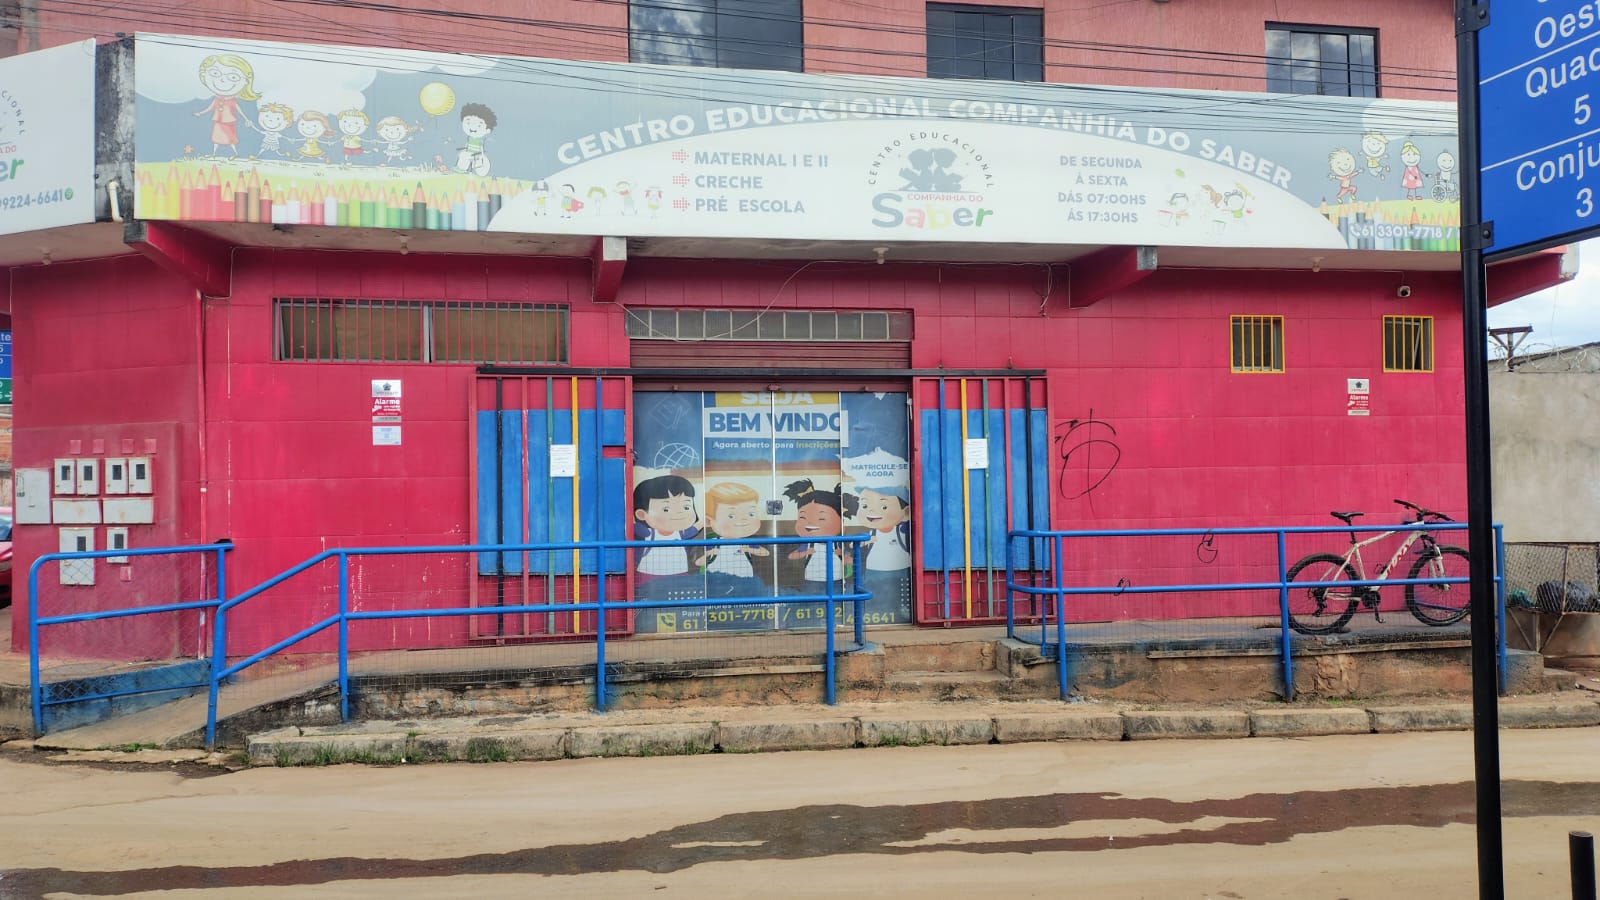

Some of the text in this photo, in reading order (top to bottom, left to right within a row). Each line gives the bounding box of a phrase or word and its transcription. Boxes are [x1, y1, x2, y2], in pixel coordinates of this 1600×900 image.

[1573, 94, 1591, 125] 5
[557, 97, 1292, 189] CENTRO EDUCACIONAL COMPANHIA DO SABER
[694, 151, 787, 167] MATERNAL
[803, 154, 813, 168] E
[818, 154, 829, 168] II
[868, 131, 994, 188] CENTRO EDUCACIONAL
[1059, 155, 1142, 169] DE SEGUNDA
[1516, 142, 1600, 192] Conju
[694, 175, 763, 189] CRECHE
[1088, 174, 1128, 187] SEXTA
[0, 188, 63, 211] 9224-6641
[695, 195, 805, 213] PRÉ ESCOLA
[907, 193, 966, 202] COMPANHIA
[1087, 193, 1147, 205] 07:00HS
[1576, 187, 1594, 218] 3
[871, 192, 994, 230] Saber
[1088, 211, 1138, 223] 17:30HS
[1361, 225, 1374, 238] 61
[1377, 225, 1443, 239] 3301-7718
[709, 412, 761, 433] BEM
[713, 441, 739, 450] Agora
[741, 441, 770, 449] aberto
[774, 442, 794, 450] para
[851, 463, 908, 471] MATRICULE-SE
[865, 470, 894, 478] AGORA
[681, 610, 701, 618] Para
[683, 618, 699, 631] 61
[704, 608, 776, 624] 301-7718
[796, 608, 811, 620] 61
